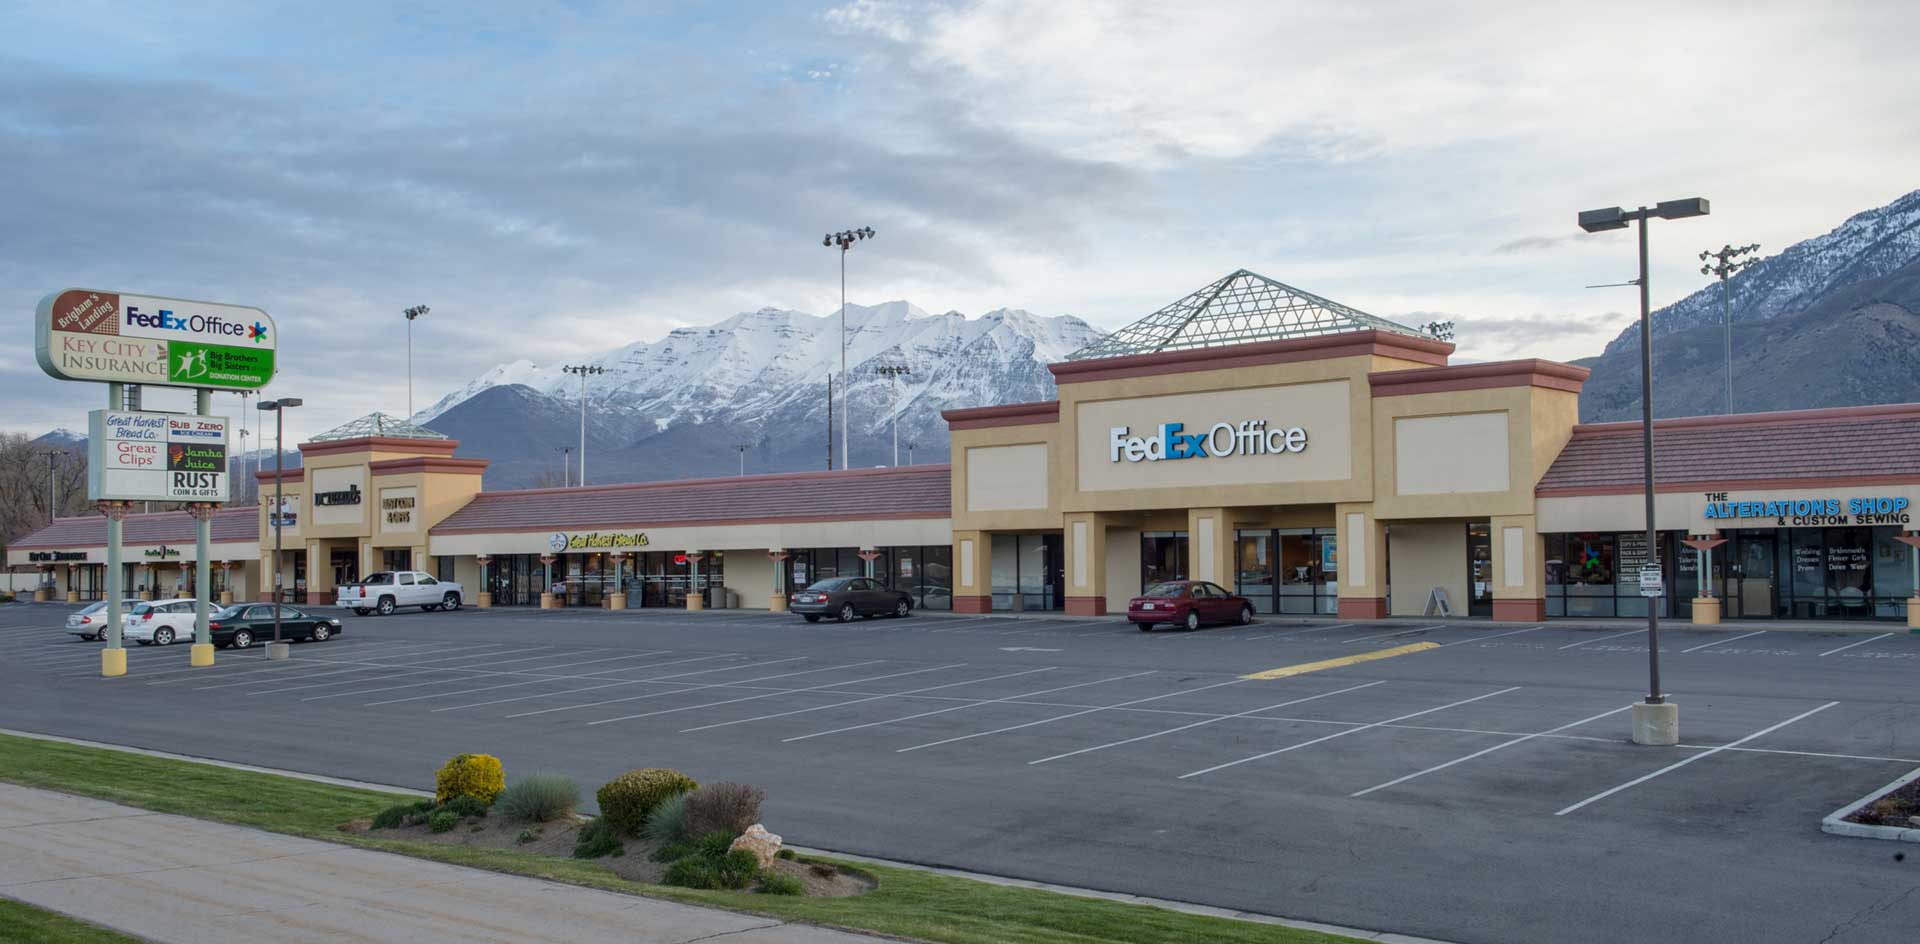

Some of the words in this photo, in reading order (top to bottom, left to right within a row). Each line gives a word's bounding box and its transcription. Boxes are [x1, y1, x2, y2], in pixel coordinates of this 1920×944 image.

[57, 293, 100, 328] Brigham's
[78, 301, 114, 331] Landing
[127, 306, 187, 331] FedEx
[189, 314, 244, 336] Office
[63, 336, 100, 353] KEY
[103, 340, 146, 358] CITY
[210, 351, 223, 361] Big
[225, 352, 258, 363] Brothers
[63, 353, 167, 376] INSURANCE
[210, 360, 223, 370] Big
[225, 361, 250, 371] Sisters
[107, 415, 132, 427] Great
[133, 415, 166, 428] Harvest
[169, 420, 191, 429] SUB
[197, 421, 224, 431] ZERO
[116, 428, 142, 439] Bread
[1110, 422, 1209, 462] FedEx
[1208, 419, 1307, 457] Office
[117, 442, 157, 454] Great
[184, 445, 223, 458] Jamba
[118, 454, 153, 467] Clips
[184, 459, 216, 470] Juice
[173, 472, 219, 489] RUST
[199, 489, 218, 497] GIFTS
[1704, 492, 1728, 502] THE
[1704, 499, 1841, 519] ALTERATIONS
[1849, 497, 1909, 515] SHOP
[1777, 516, 1786, 526] &
[1792, 515, 1848, 525] CUSTOM
[1855, 513, 1910, 524] SEWING
